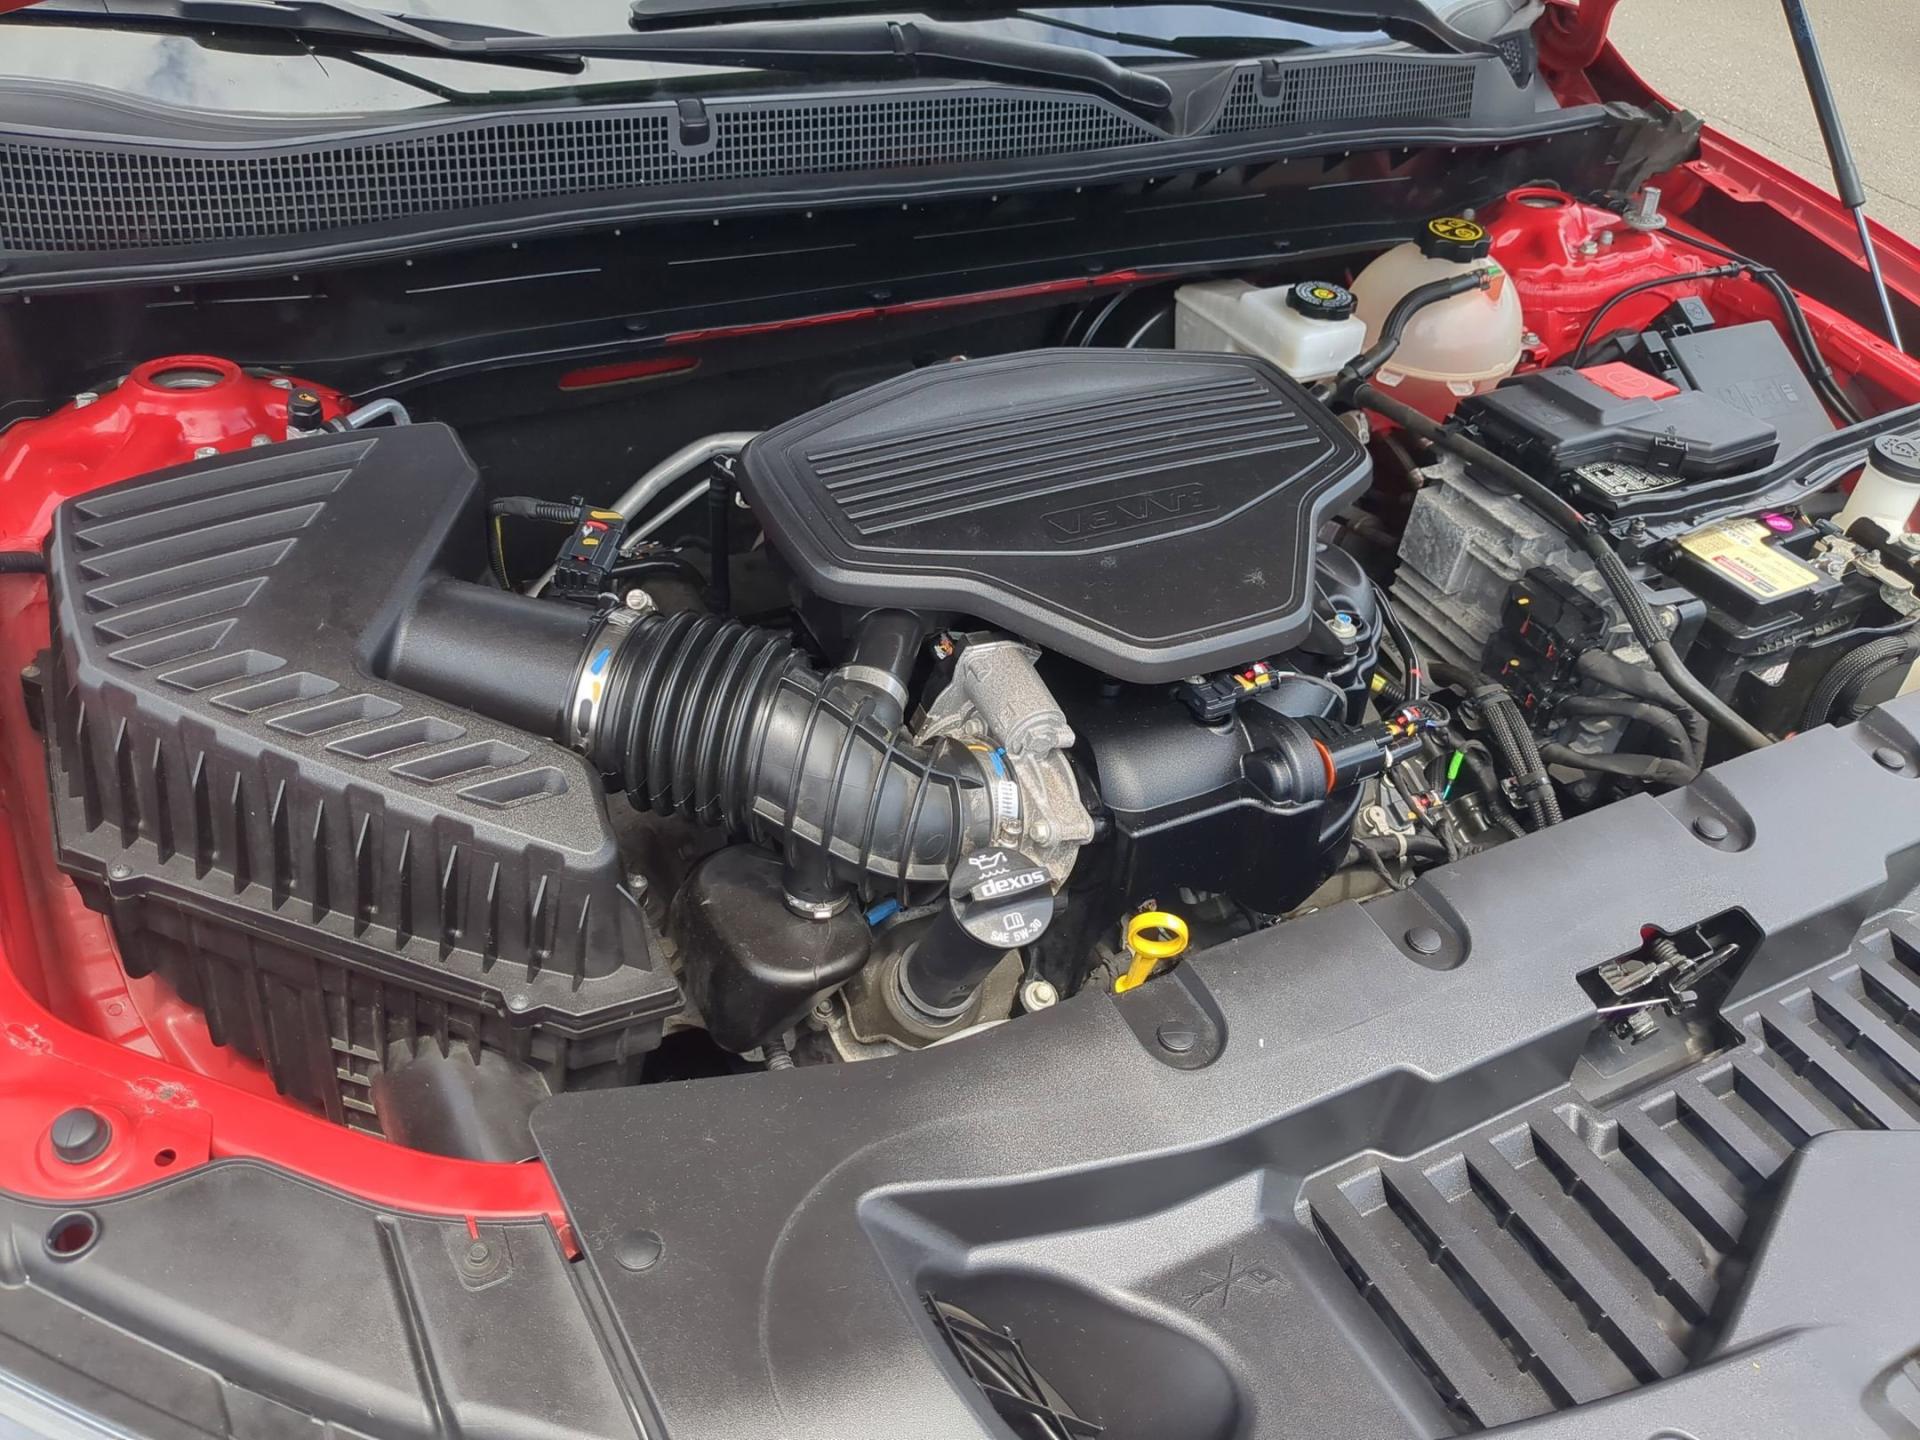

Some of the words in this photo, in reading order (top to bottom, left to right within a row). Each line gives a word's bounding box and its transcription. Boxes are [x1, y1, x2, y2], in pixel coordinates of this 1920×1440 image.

[981, 871, 1045, 897] dexos
[991, 930, 1010, 943] SAE
[1013, 918, 1042, 942] 5W-30
